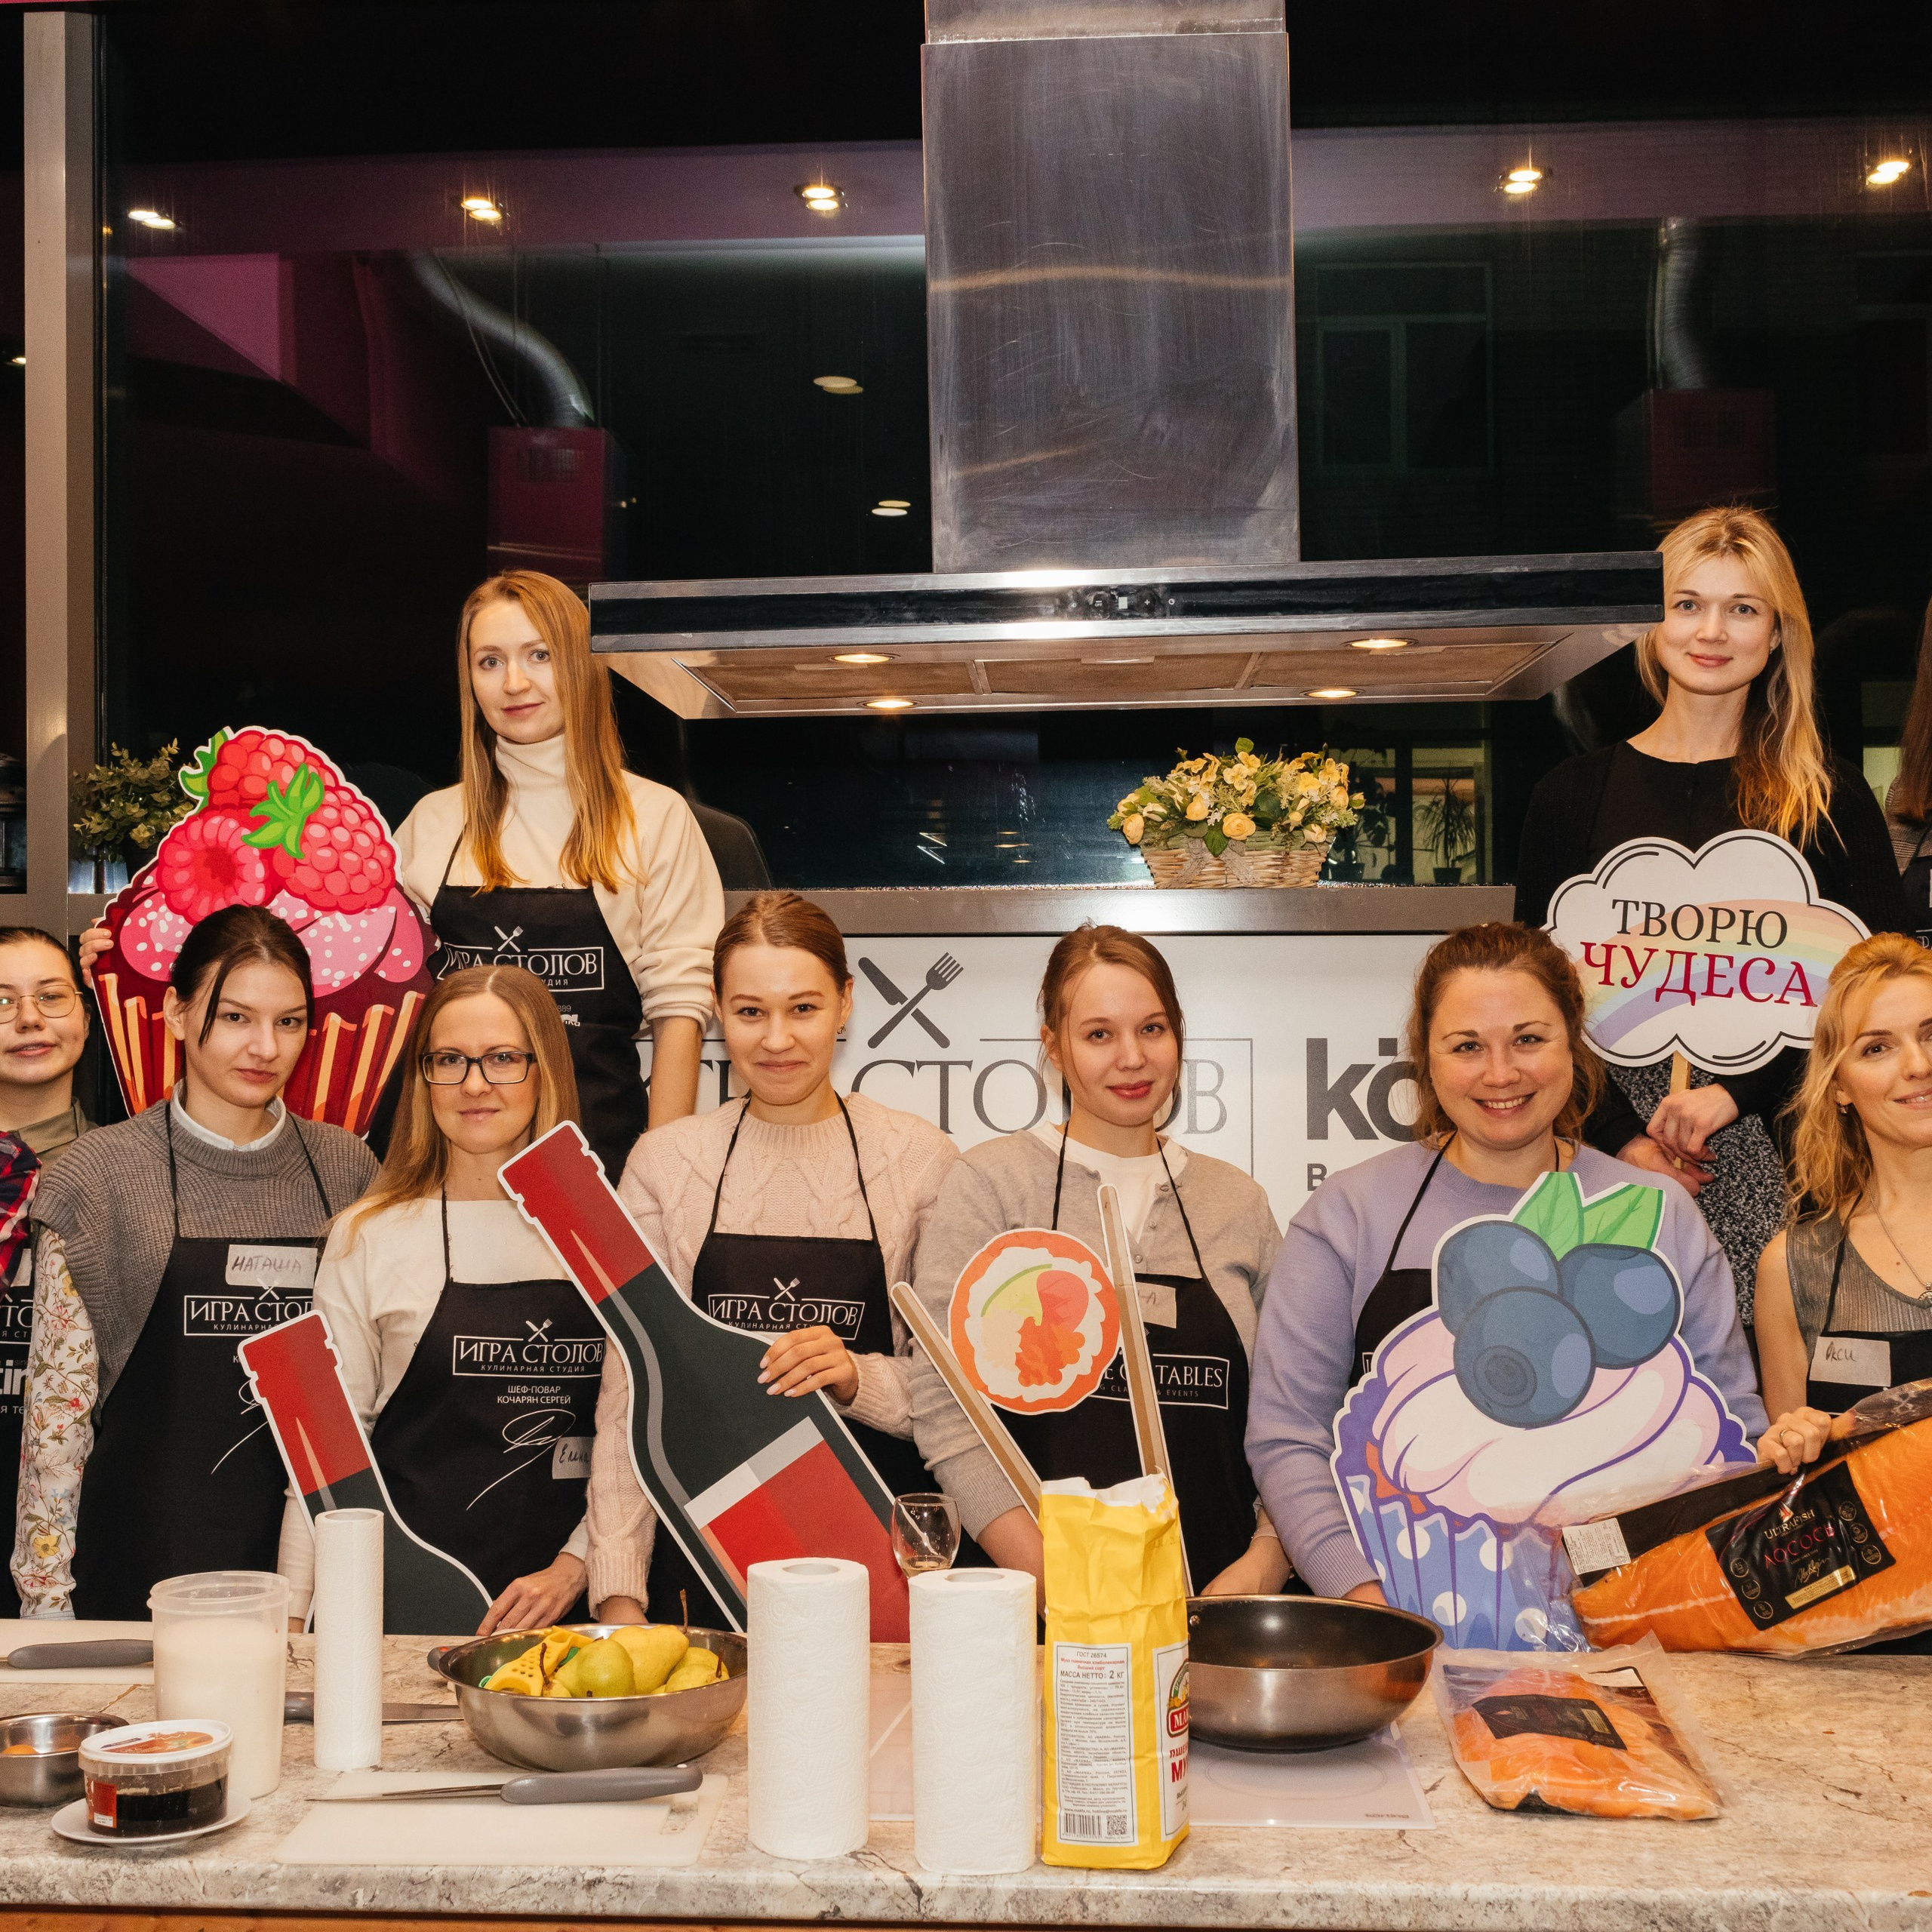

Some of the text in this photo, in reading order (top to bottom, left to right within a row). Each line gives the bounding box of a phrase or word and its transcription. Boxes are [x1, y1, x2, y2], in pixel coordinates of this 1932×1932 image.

[1611, 899, 1788, 949] ТВОРЮ
[1580, 941, 1819, 1008] ЧУДЕСА
[852, 1058, 1228, 1134] СТОВ
[190, 1300, 251, 1321] ИГРА
[712, 1299, 859, 1326] ИГРА СТОЛОВ
[460, 1340, 604, 1364] ИГРА СТОЛОВ
[481, 1364, 545, 1373] КУЛИНАРНАЯ
[1155, 1364, 1223, 1388] TABLES
[508, 1385, 561, 1394] ШЕФ-ПОВАР
[540, 1395, 571, 1404] СЕРГЕЙ
[1166, 1389, 1199, 1397] EVENTS
[1764, 1509, 1816, 1540] ULTRAFISH
[1109, 1670, 1115, 1679] 2
